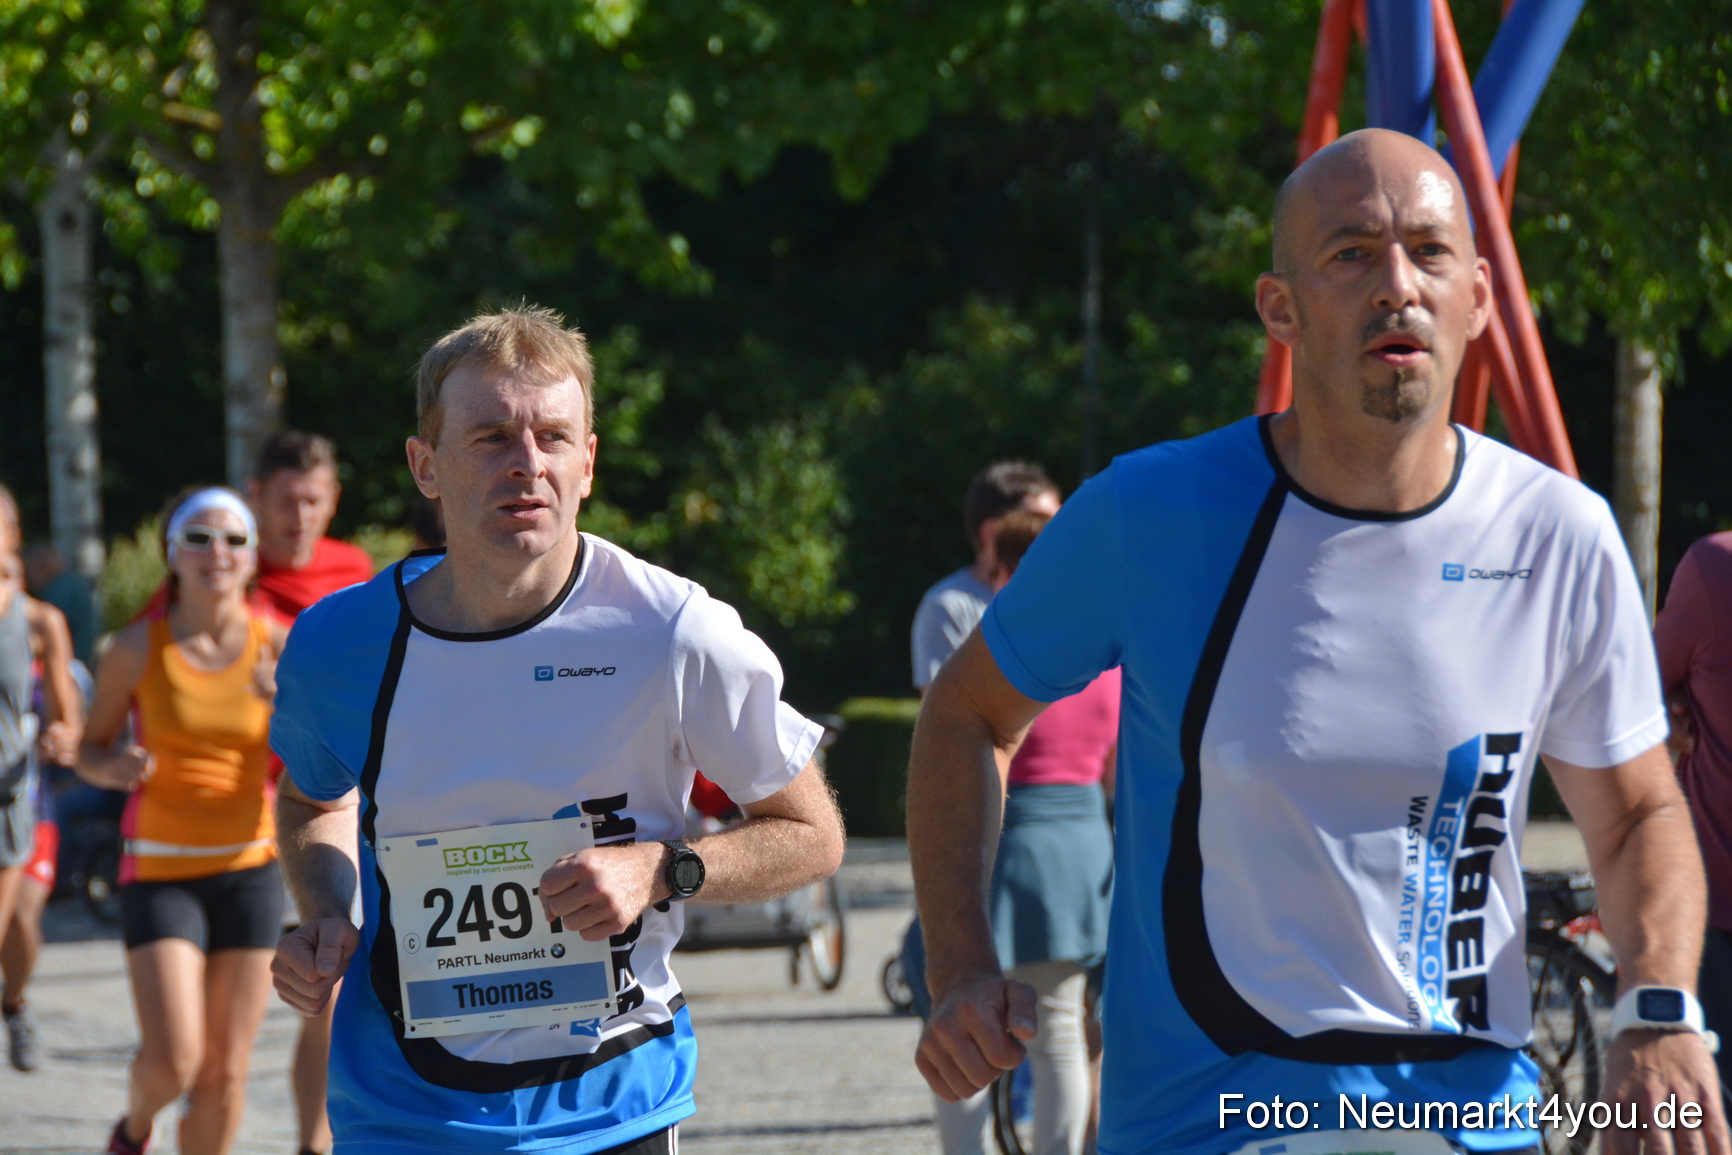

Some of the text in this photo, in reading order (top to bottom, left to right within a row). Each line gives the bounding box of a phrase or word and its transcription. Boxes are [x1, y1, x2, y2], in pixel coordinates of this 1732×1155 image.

[442, 841, 532, 868] BOCK
[473, 867, 480, 875] by
[502, 863, 534, 872] concepts
[1446, 731, 1523, 1034] HUBER
[1396, 795, 1429, 1031] WASTE WATER Solions
[1421, 796, 1465, 1029] TECHNOLOGY
[408, 937, 416, 950] C
[437, 947, 546, 970] PARTL Neumarkt
[452, 979, 554, 1009] Thomas
